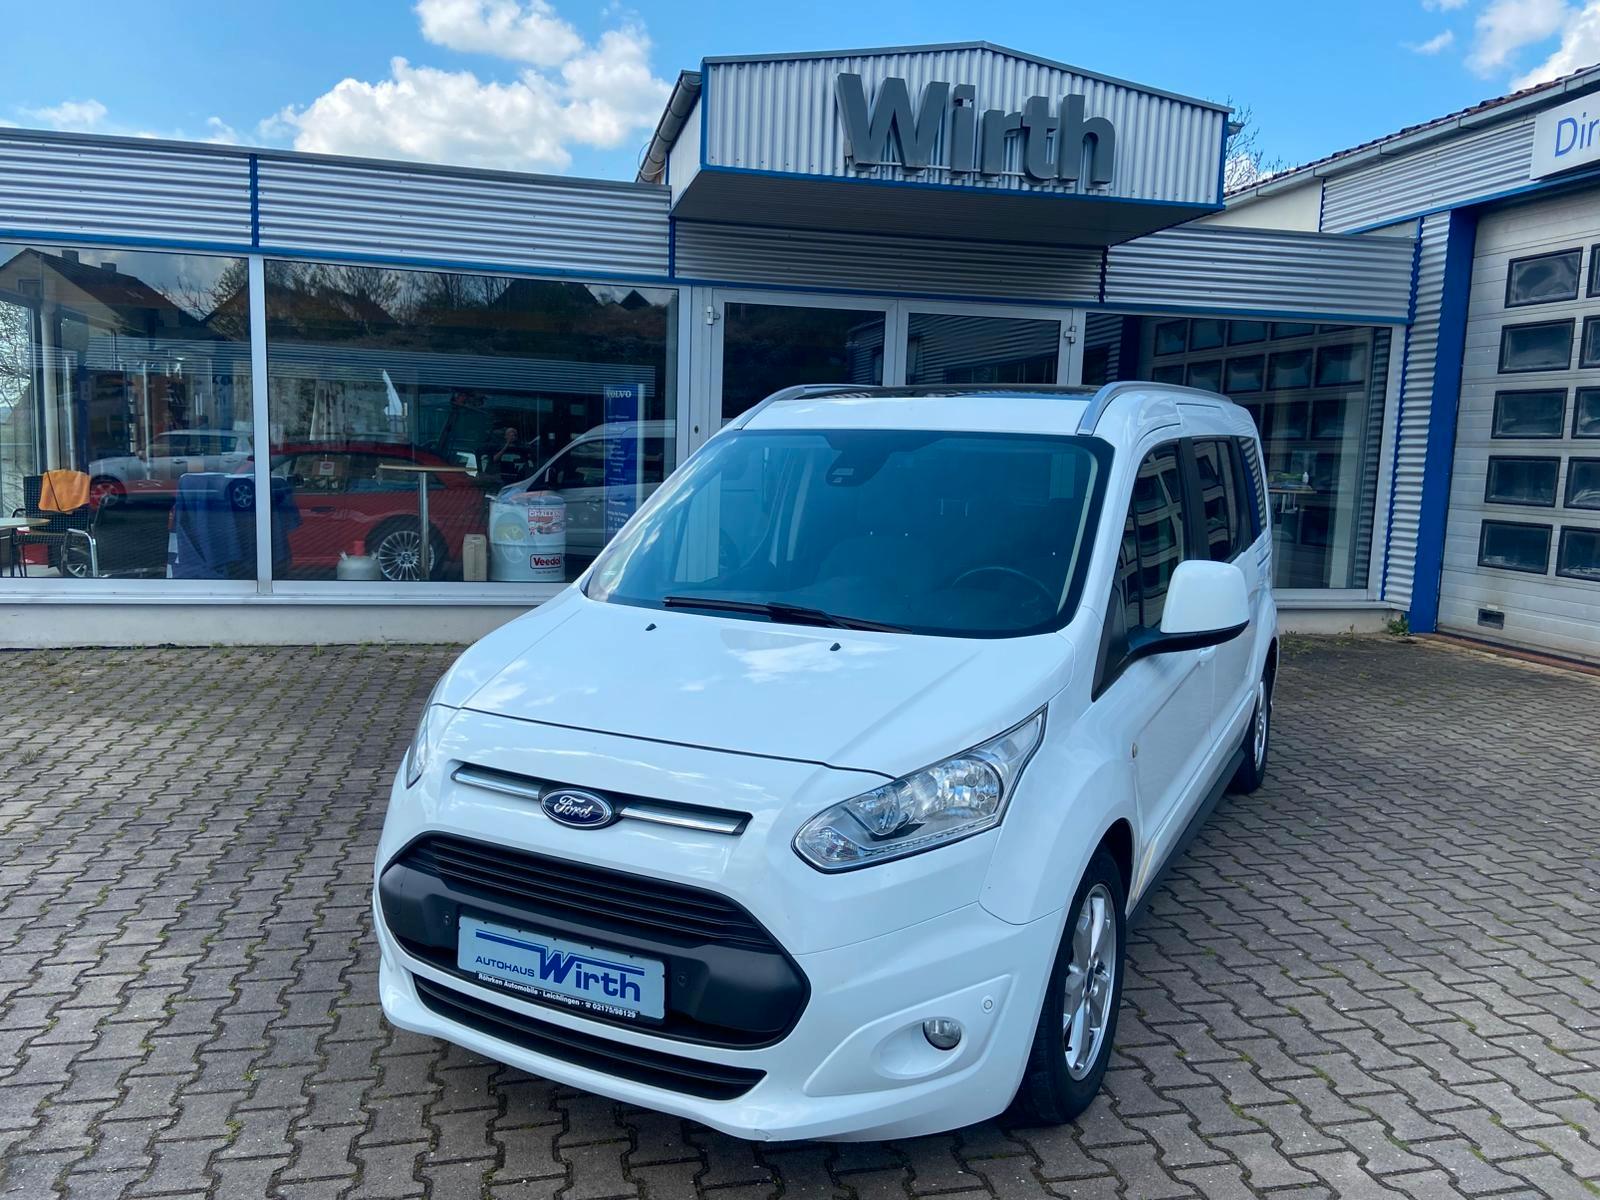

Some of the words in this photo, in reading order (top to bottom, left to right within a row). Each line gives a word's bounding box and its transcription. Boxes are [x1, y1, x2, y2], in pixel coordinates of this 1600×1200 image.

[836, 73, 1116, 185] Wirth
[1555, 112, 1600, 158] Dir
[606, 390, 632, 398] VOLVO
[533, 556, 561, 566] Veedol
[553, 795, 594, 819] Ford
[475, 955, 535, 978] AUTOHAUS
[539, 948, 641, 1003] Wirth
